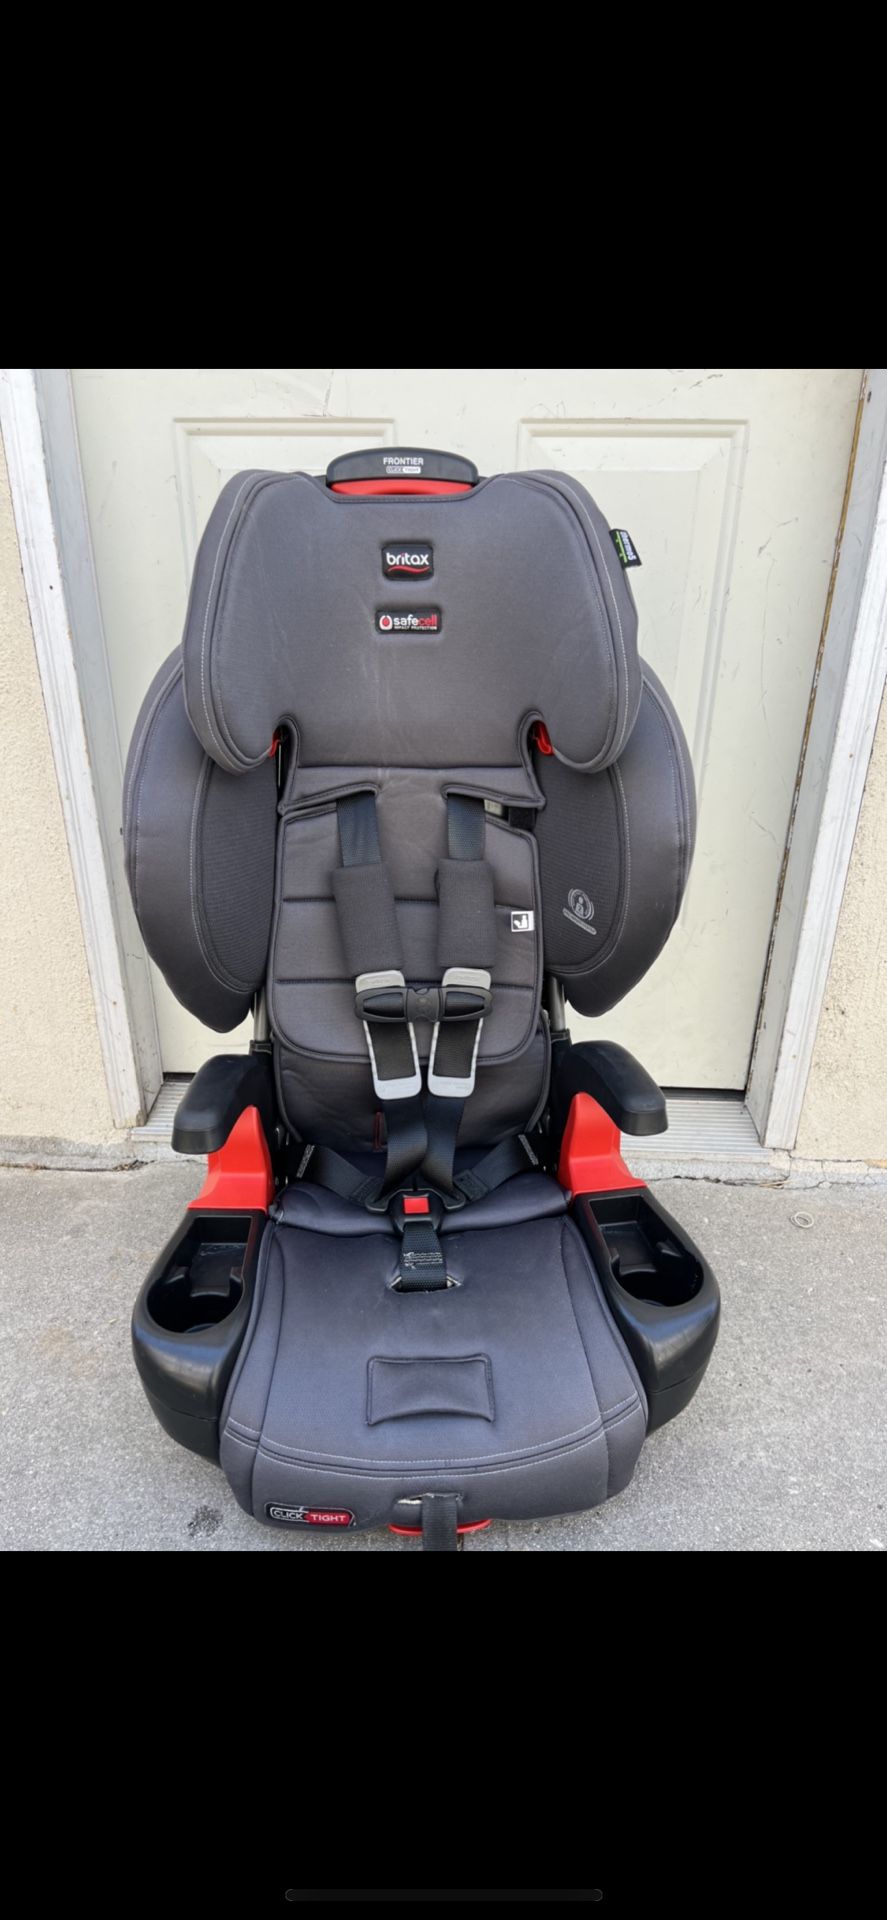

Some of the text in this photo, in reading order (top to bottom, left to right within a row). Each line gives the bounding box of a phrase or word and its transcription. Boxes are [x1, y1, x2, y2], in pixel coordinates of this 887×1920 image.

[383, 457, 424, 466] FRONTIER
[386, 552, 429, 566] britax
[393, 614, 437, 626] safecell
[273, 1510, 346, 1522] CLICK TIGHT
